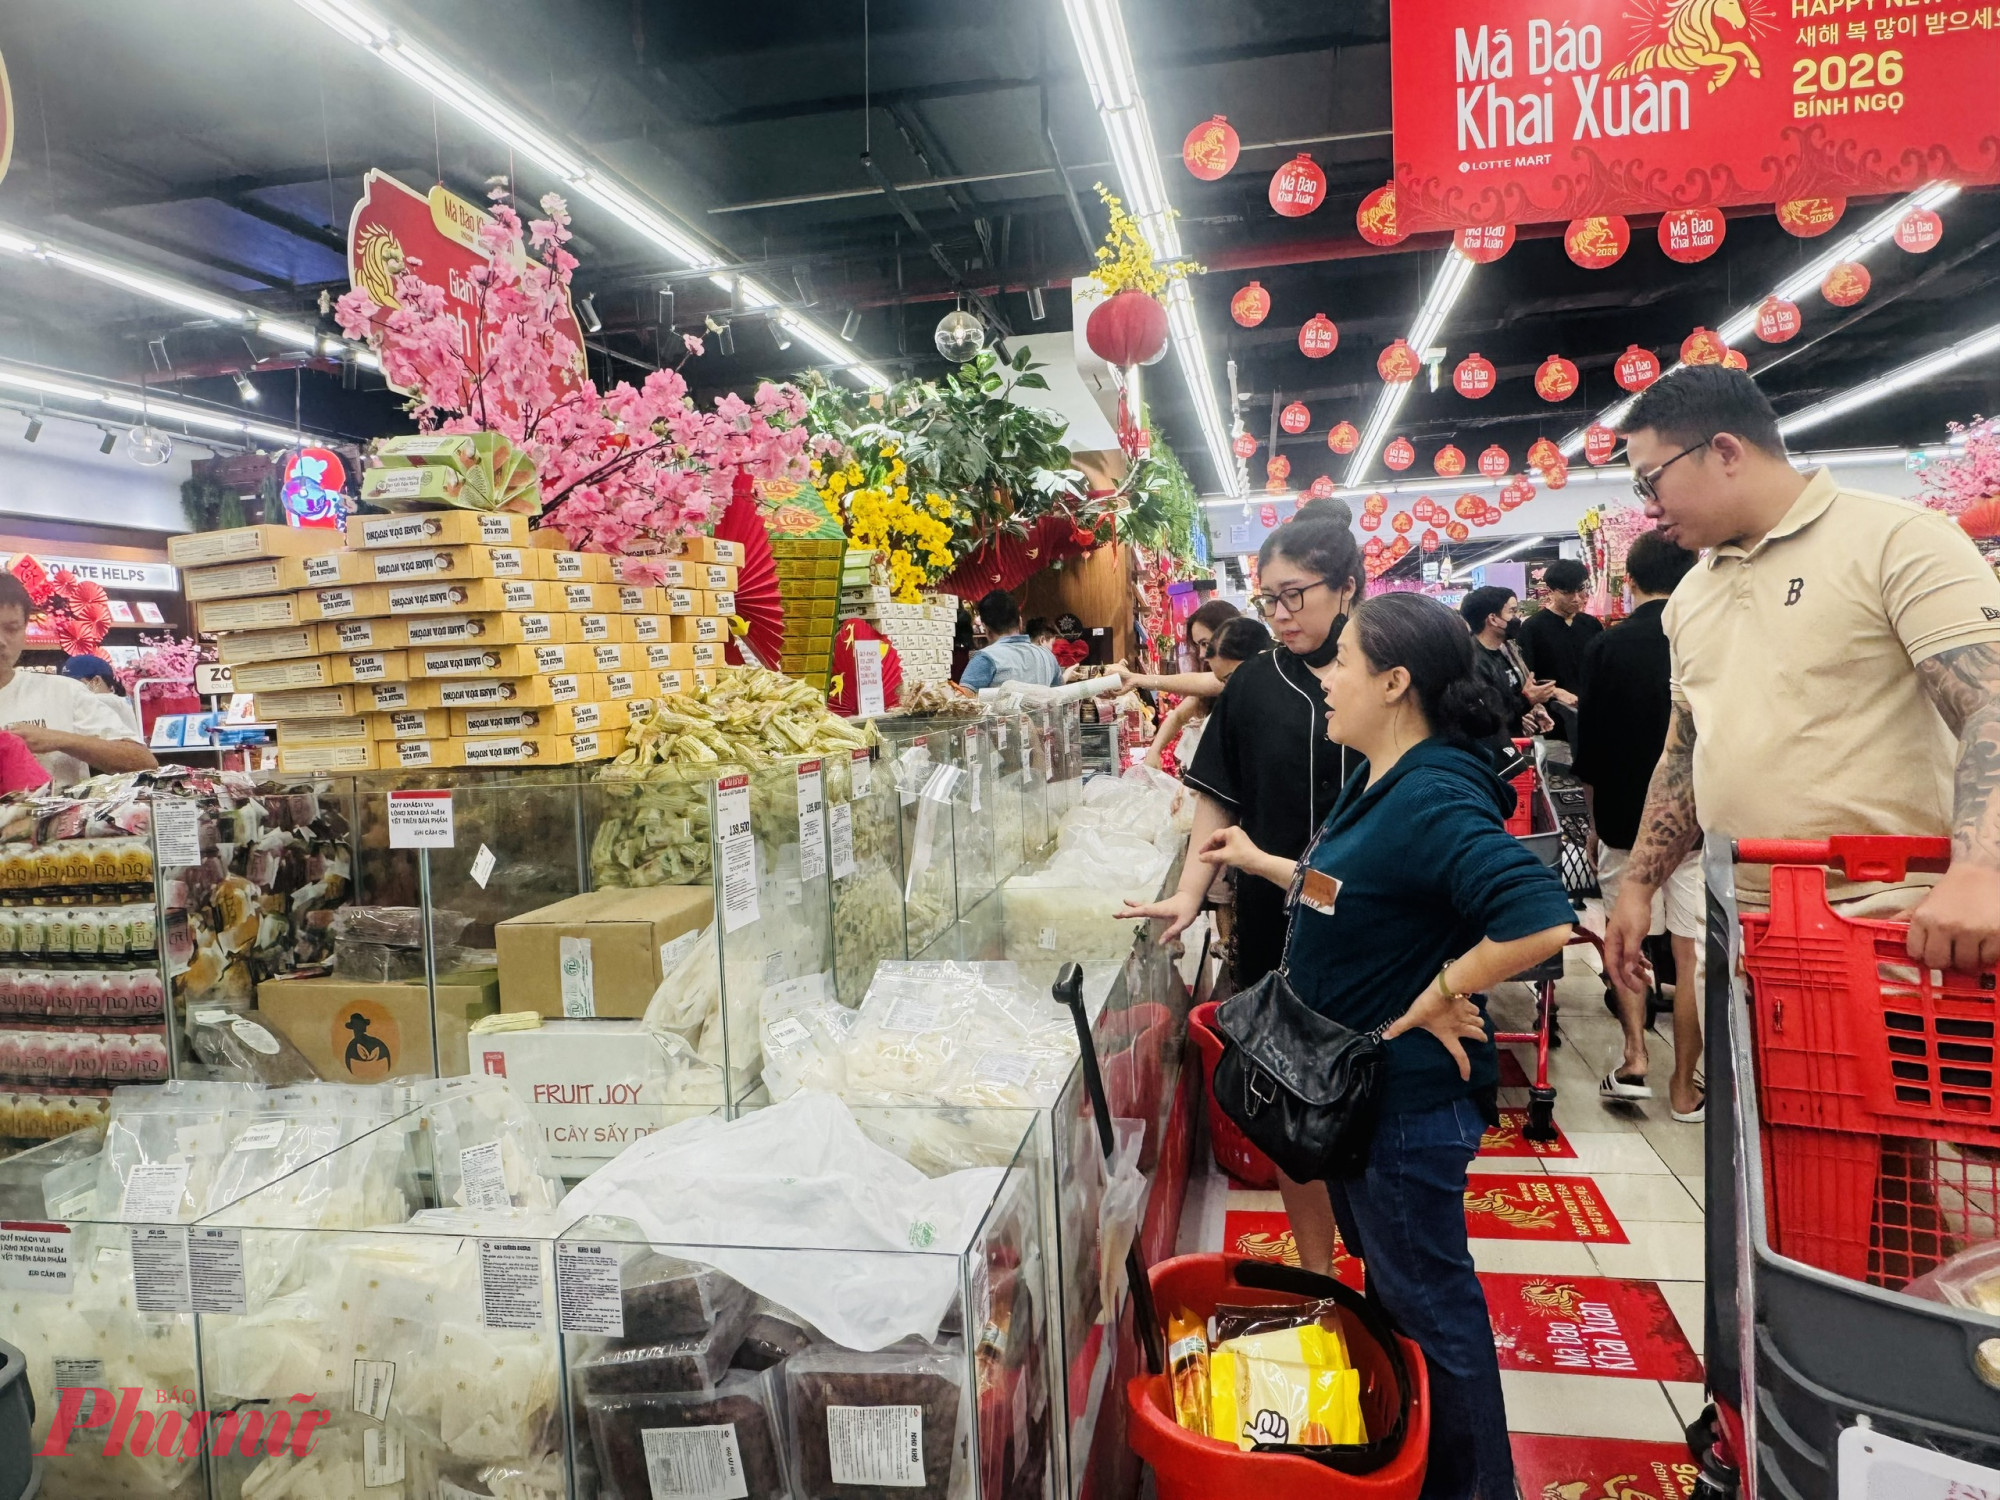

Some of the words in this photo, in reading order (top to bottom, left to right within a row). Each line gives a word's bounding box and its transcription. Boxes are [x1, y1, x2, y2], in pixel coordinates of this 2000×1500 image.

[1796, 23, 1838, 47] 새해
[1846, 21, 1867, 42] 복
[1874, 14, 1917, 40] 많이
[1455, 25, 1513, 82] Mã
[1528, 19, 1602, 75] Đáo
[1793, 50, 1904, 95] 2026
[1457, 76, 1553, 151] Khai
[1572, 74, 1690, 140] Xuân
[1793, 94, 1848, 118] BÍNH
[1854, 91, 1904, 114] NGỌ
[1472, 160, 1512, 171] LOTTE
[1515, 154, 1552, 167] MART
[1810, 213, 1834, 223] 2026
[102, 567, 145, 581] HELPS
[1784, 577, 1804, 606] B
[533, 1083, 594, 1104] FRUIT
[598, 1084, 643, 1104] JOY
[594, 1122, 629, 1142] SẤY
[1530, 1183, 1555, 1203] 2026
[1563, 1200, 1581, 1216] NEW
[1570, 1217, 1591, 1237] HAPPY
[1577, 1302, 1622, 1336] Xuân
[1546, 1322, 1584, 1345] Đáo
[1552, 1348, 1592, 1368] Mã
[1582, 1338, 1638, 1371] Khai
[1671, 1463, 1699, 1495] 026
